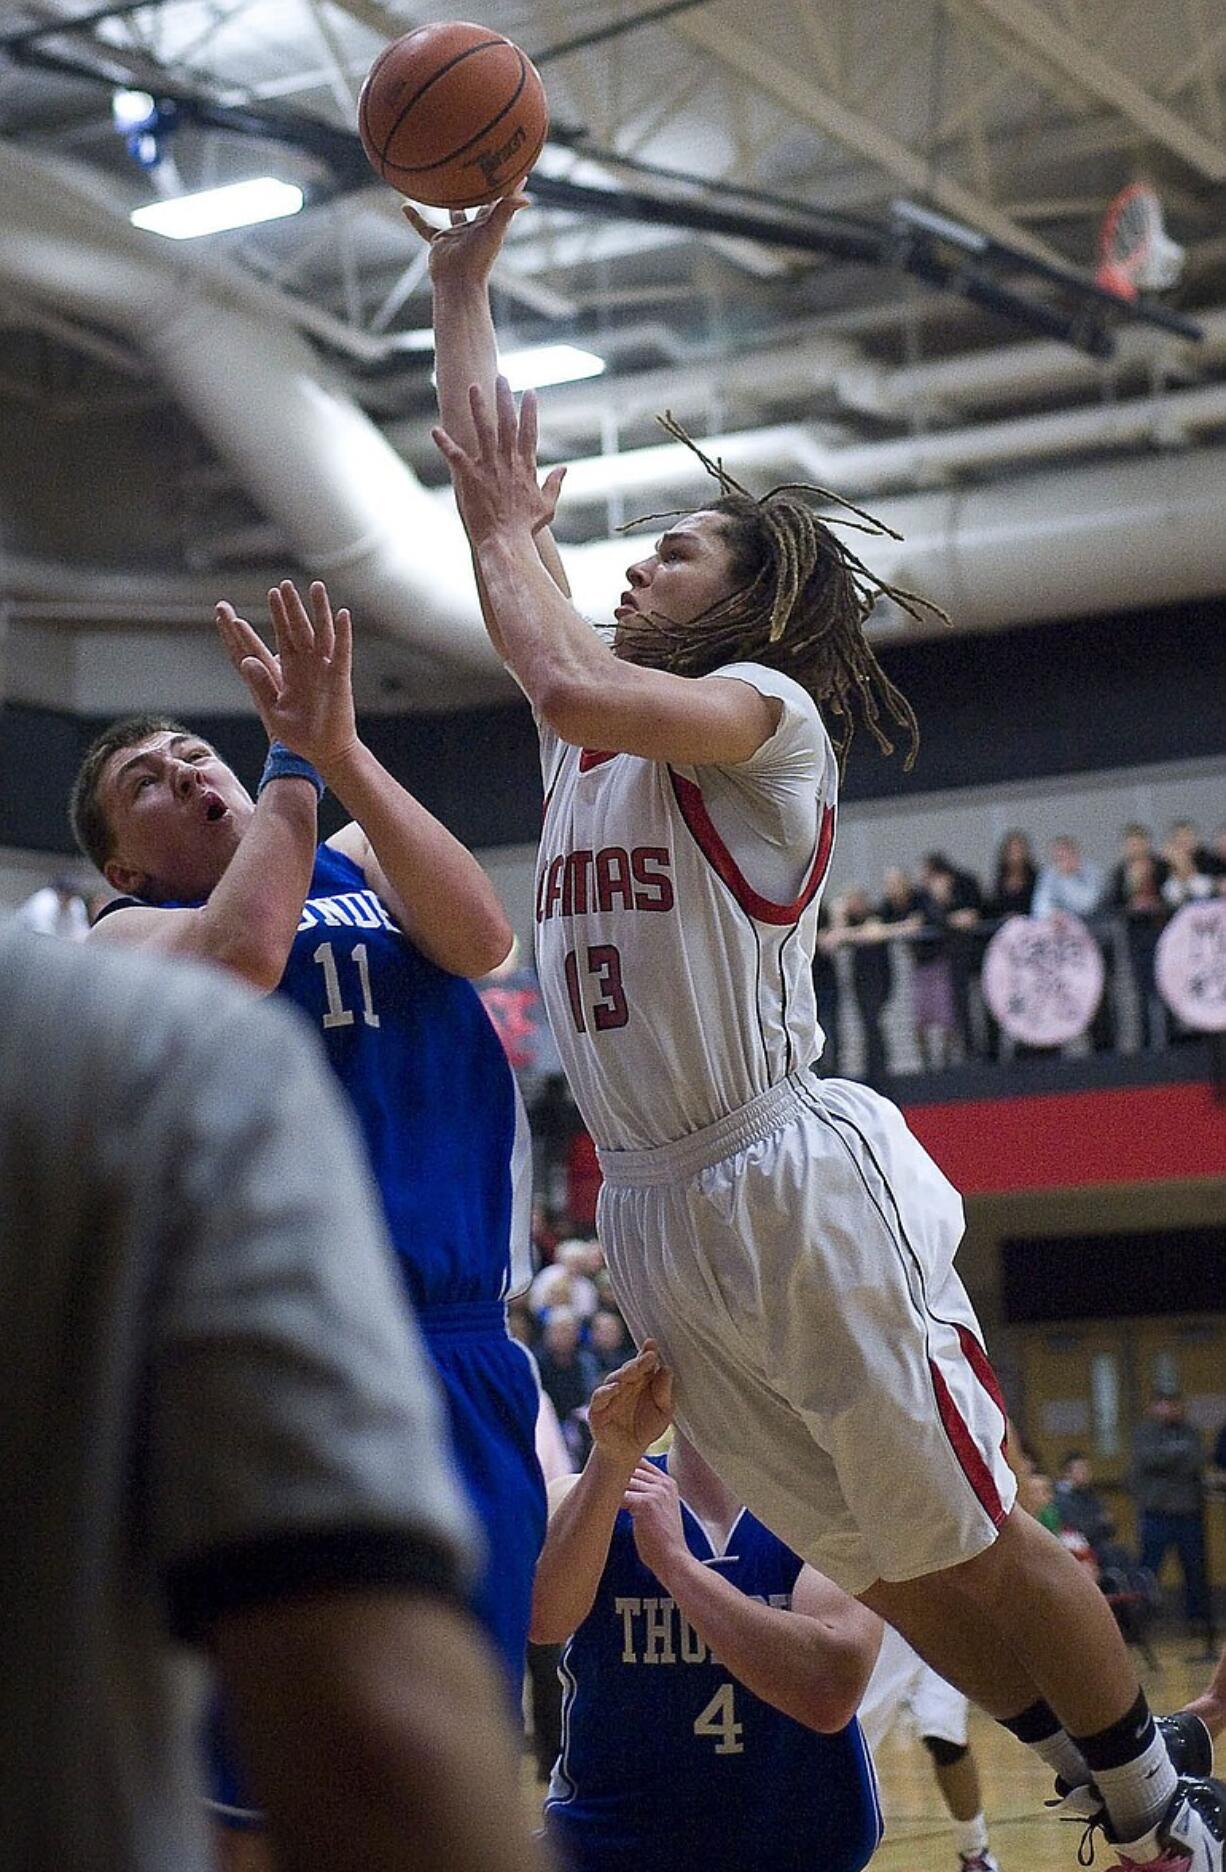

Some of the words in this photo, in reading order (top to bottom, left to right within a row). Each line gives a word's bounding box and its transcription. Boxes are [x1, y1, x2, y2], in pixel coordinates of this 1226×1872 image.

[313, 942, 380, 1028] 11
[564, 944, 630, 1033] 13
[693, 1683, 744, 1754] 4
